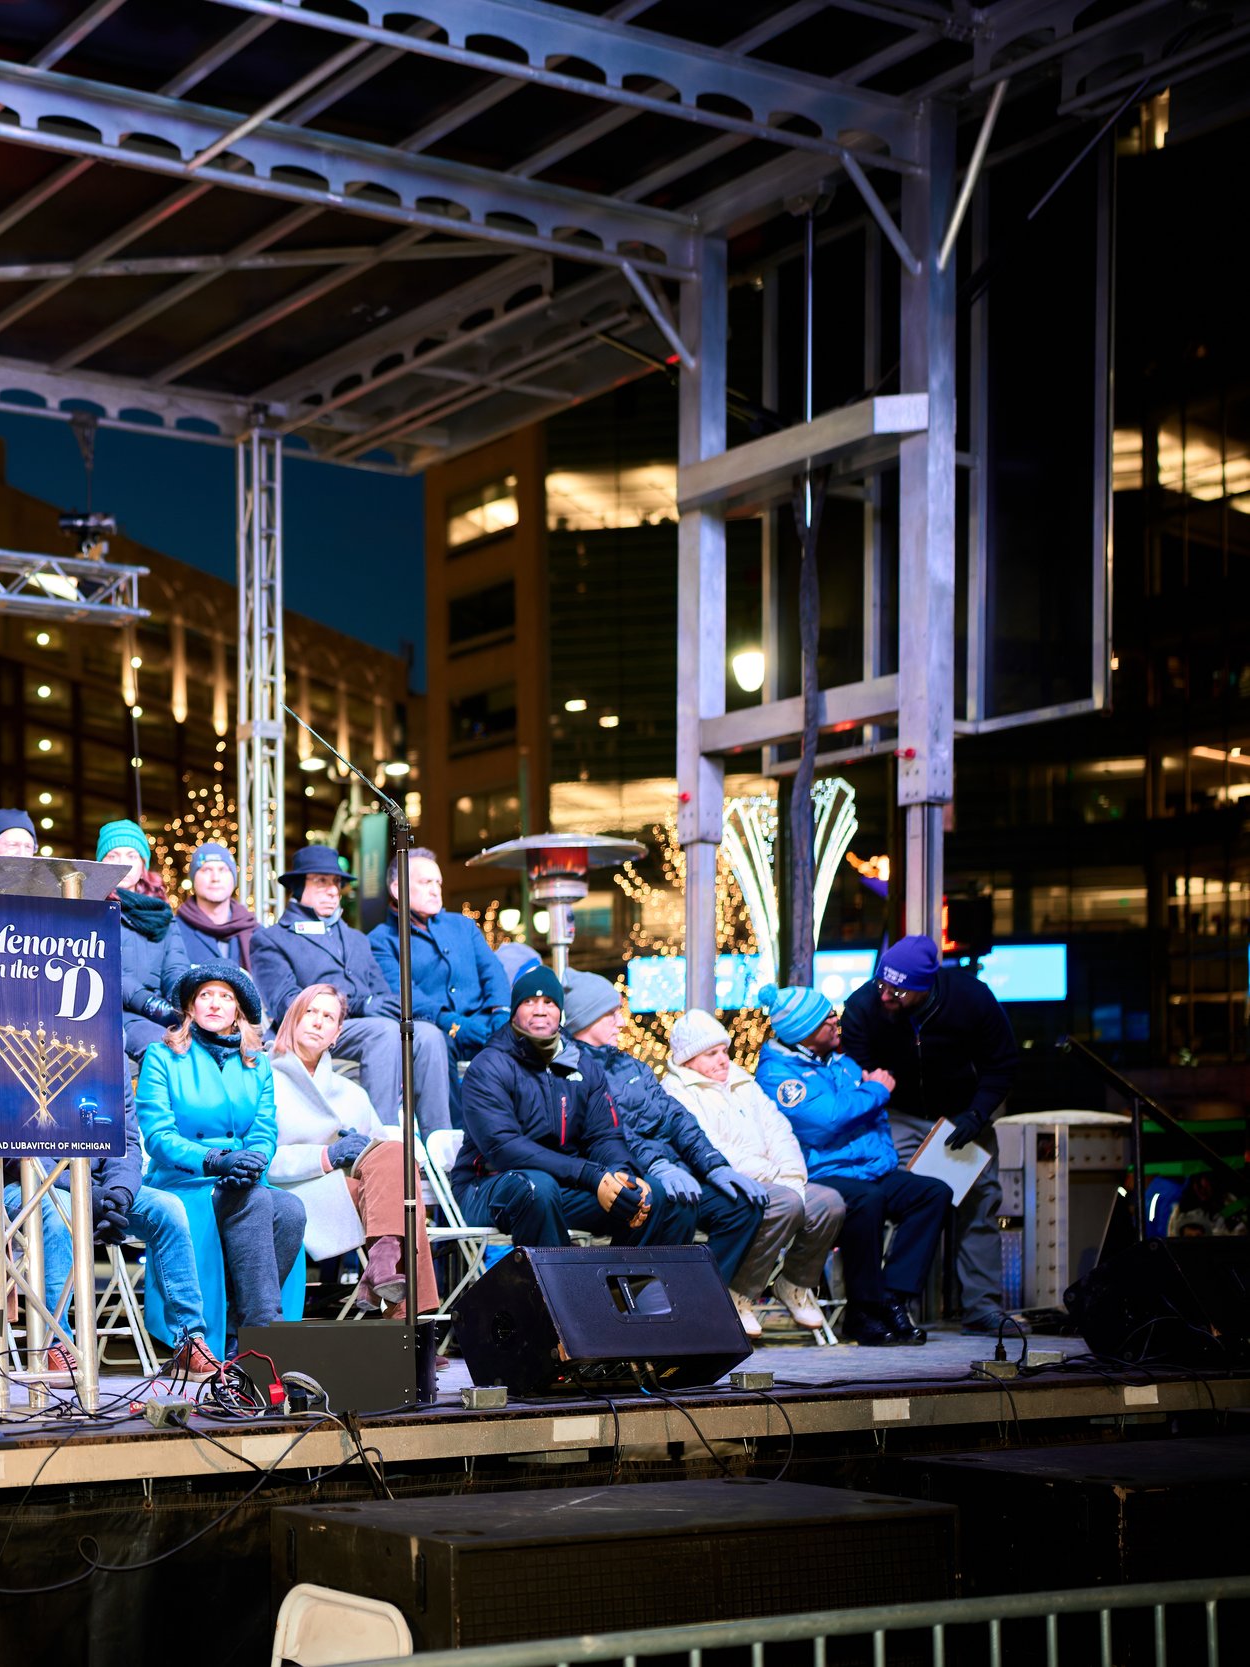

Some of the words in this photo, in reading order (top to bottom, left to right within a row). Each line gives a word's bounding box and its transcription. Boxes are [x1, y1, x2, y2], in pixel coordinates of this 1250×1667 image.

[10, 958, 40, 980] the
[44, 957, 105, 1021] D
[10, 1141, 56, 1150] LUBAVITCH
[57, 1142, 70, 1150] OF
[71, 1142, 111, 1151] MICHIGAN
